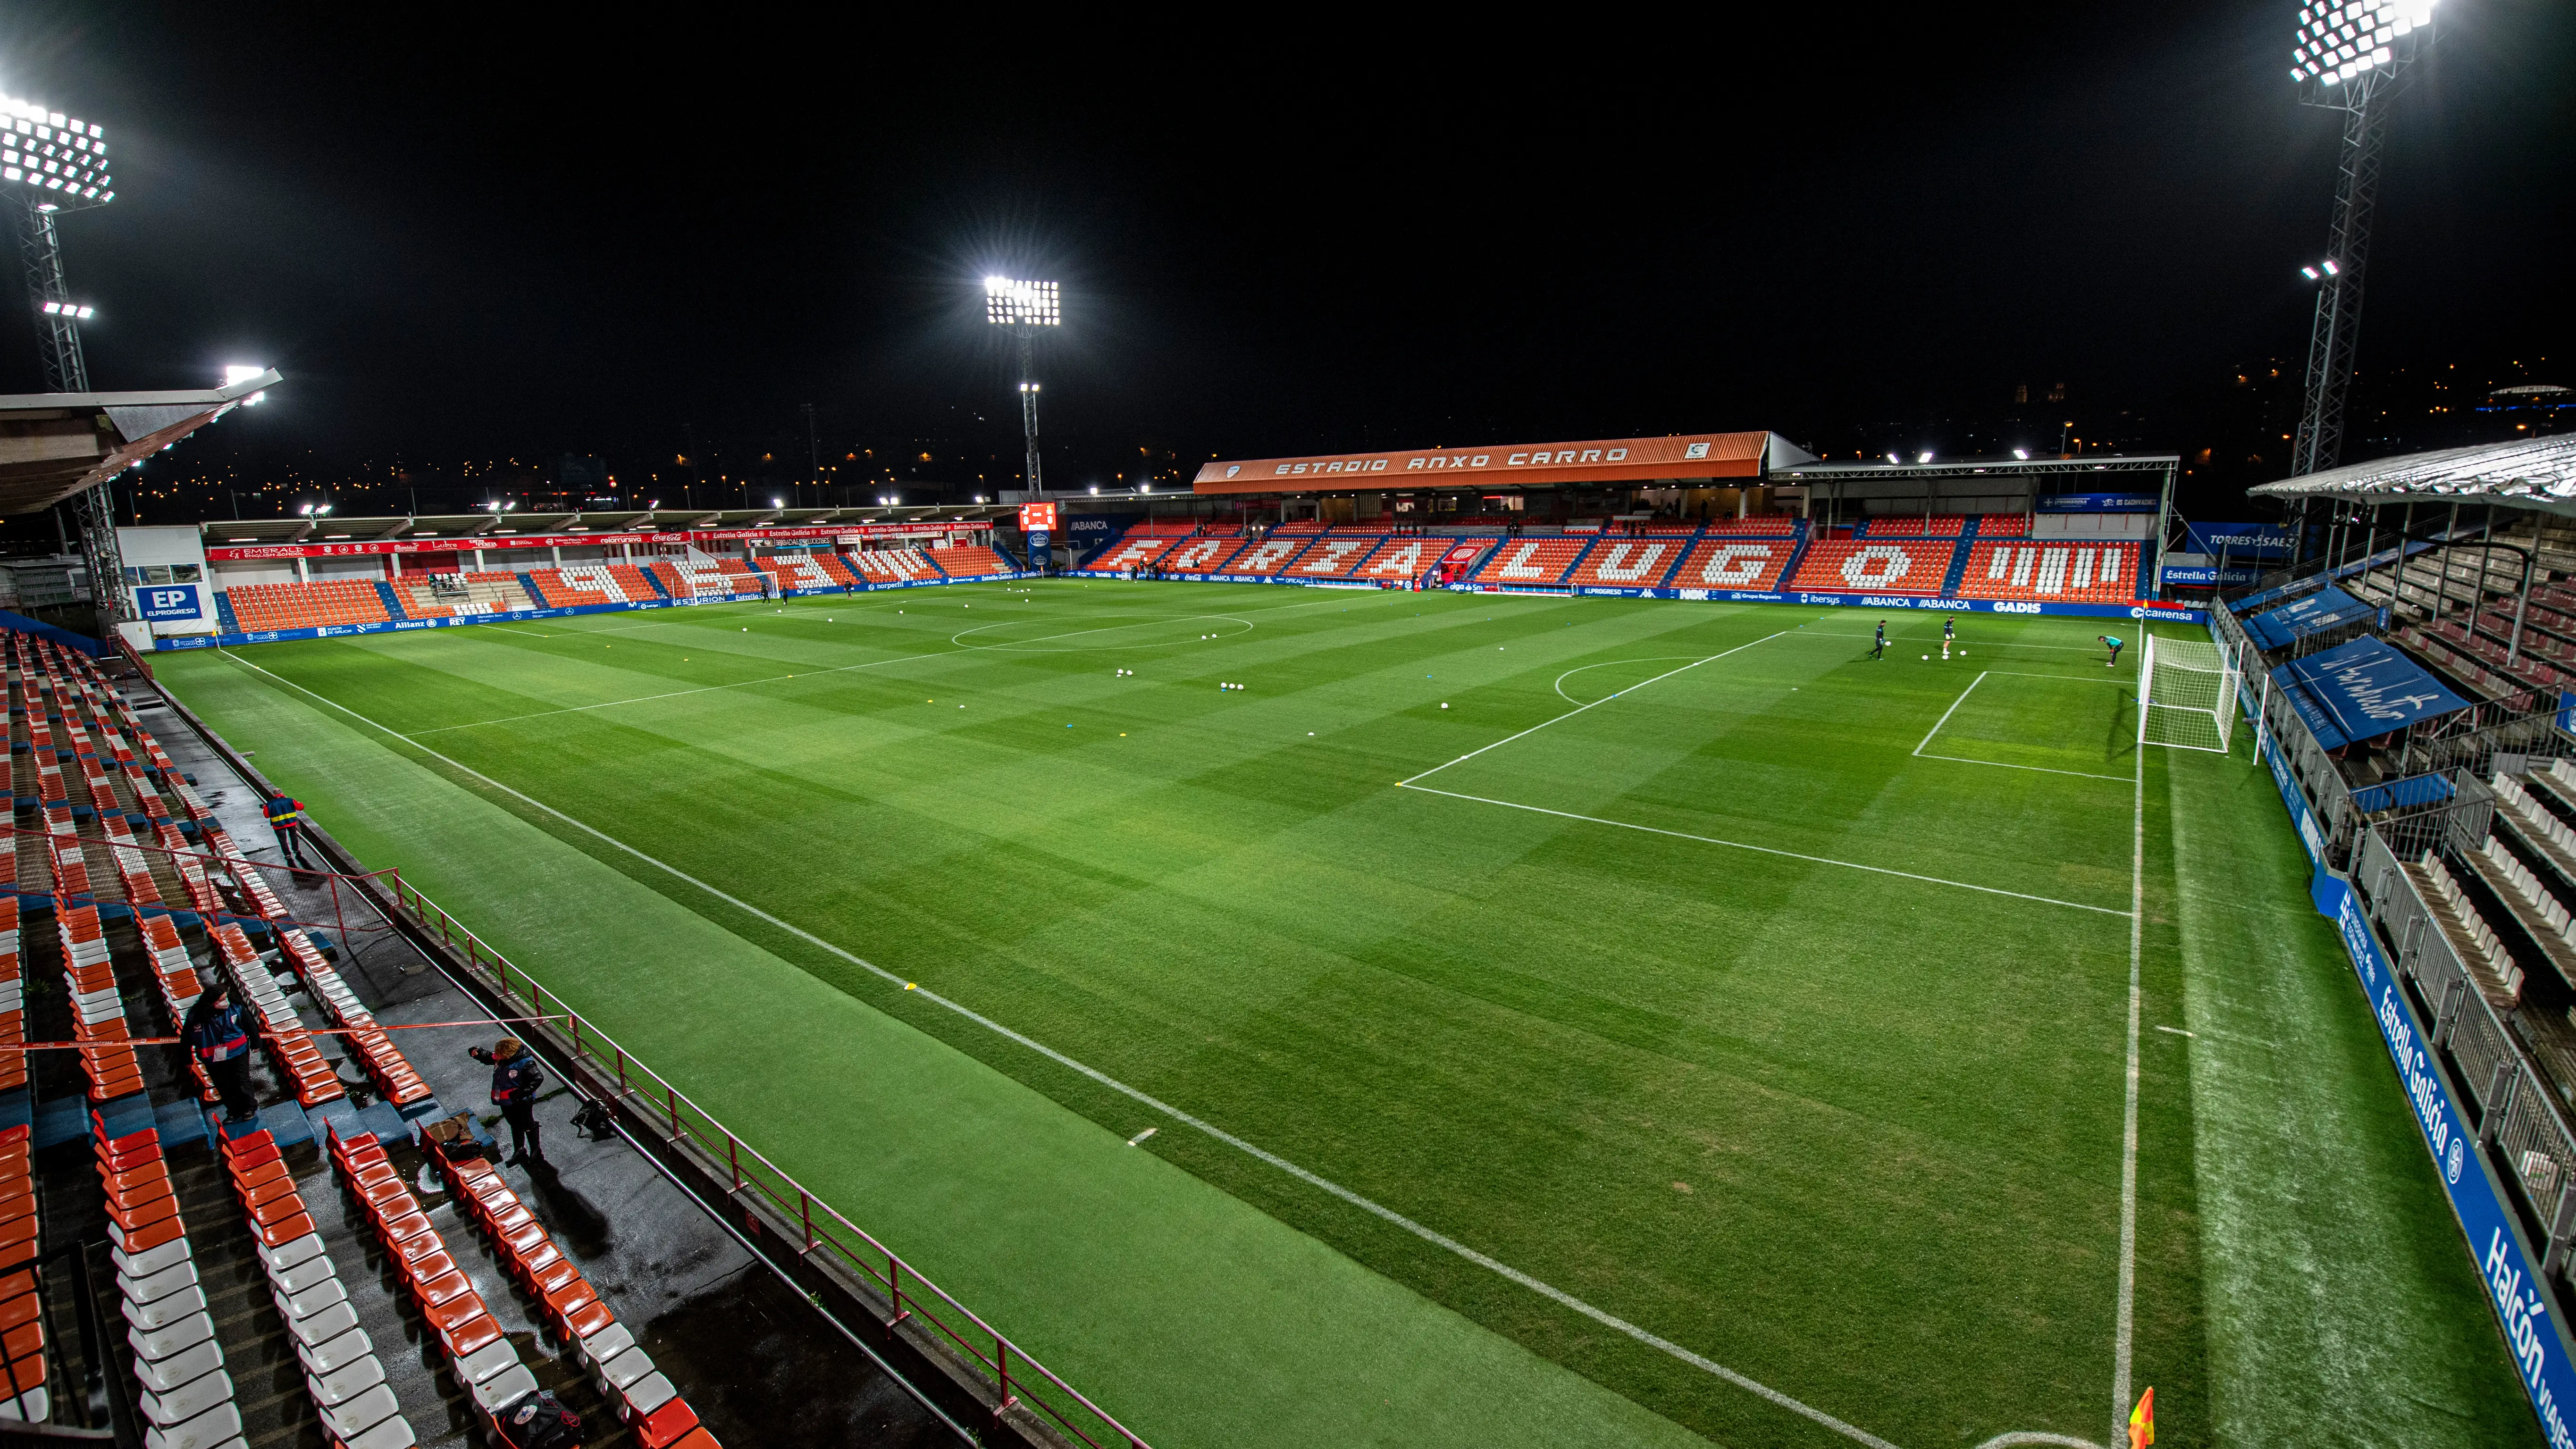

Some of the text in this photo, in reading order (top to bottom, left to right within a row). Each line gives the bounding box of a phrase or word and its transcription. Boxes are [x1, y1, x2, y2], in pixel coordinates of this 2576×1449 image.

[1275, 448, 1628, 475] ESTADIO ANXO CARRO
[1074, 520, 1108, 530] ABANCA
[652, 533, 683, 542] Coca-Cola
[2210, 535, 2251, 545] TORRES
[2165, 570, 2246, 581] Estrella Galicia
[877, 581, 904, 589] norperfil
[152, 590, 186, 608] EP
[1810, 595, 1840, 605] ibersys
[1865, 596, 1911, 607] ABANCA
[1923, 599, 1971, 610] ABANCA
[1993, 602, 2041, 614] GADIS
[147, 608, 197, 617] ELPROGRESO
[395, 621, 425, 629] Allianz
[449, 618, 465, 626] REY
[2380, 985, 2448, 1156] Estrella Galicia
[2485, 1227, 2575, 1449] Halcón VIAJE
